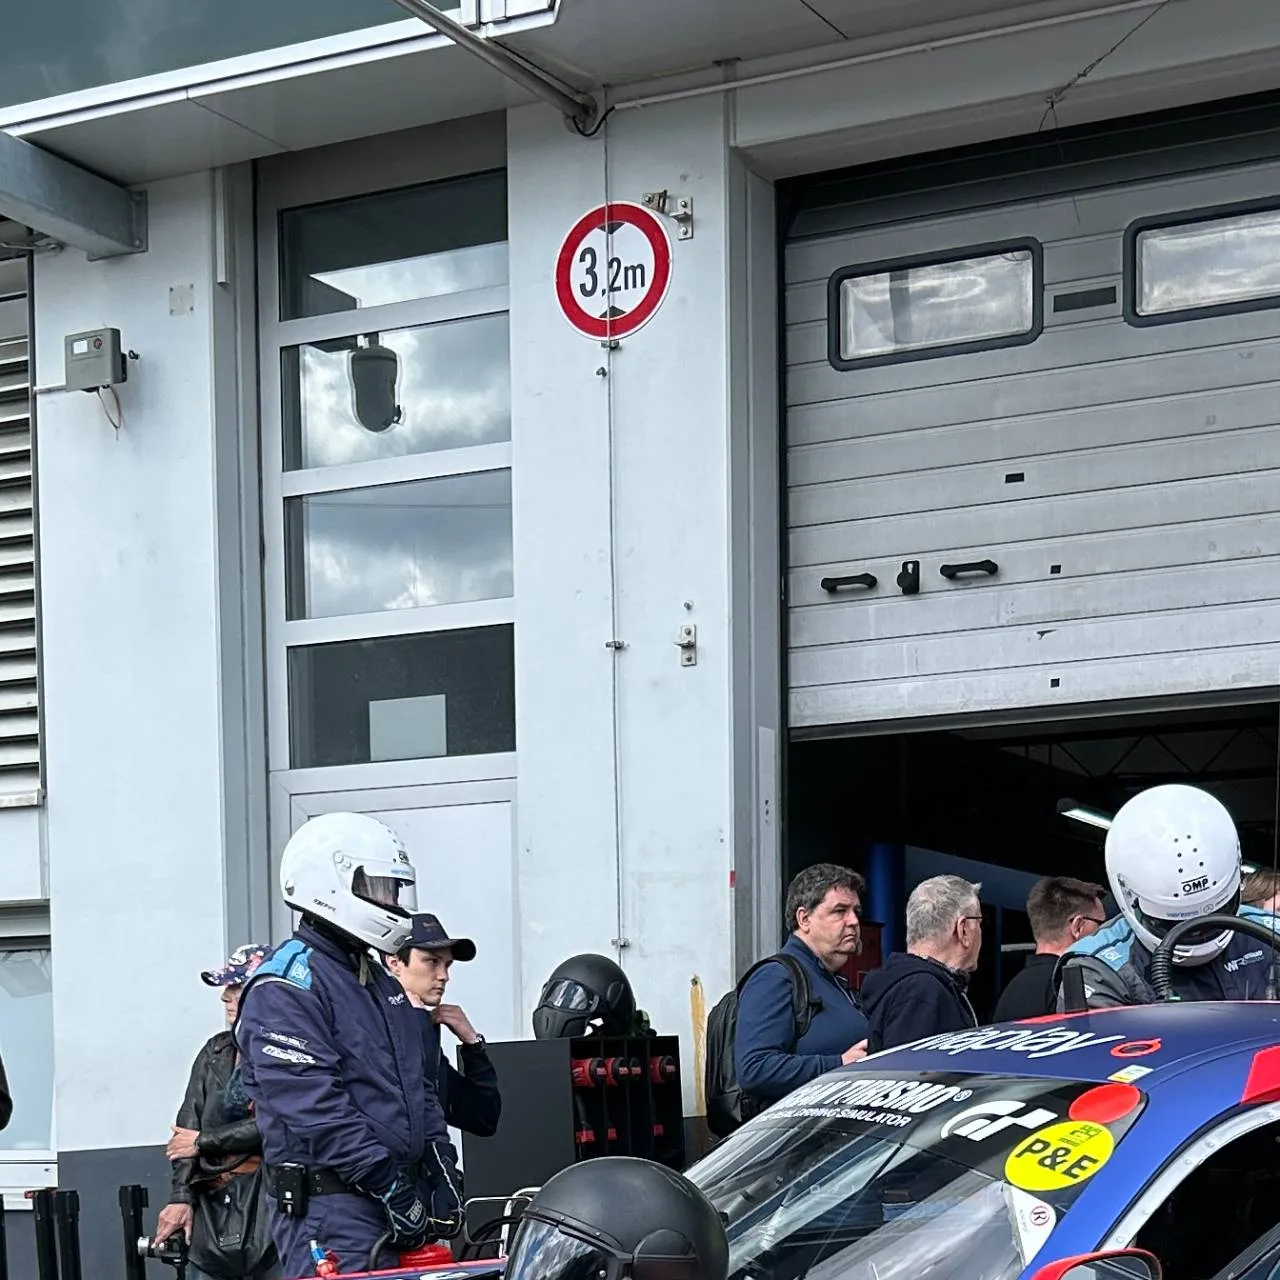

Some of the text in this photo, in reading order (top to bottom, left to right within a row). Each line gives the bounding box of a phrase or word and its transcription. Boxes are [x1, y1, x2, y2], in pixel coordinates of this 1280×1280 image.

[579, 247, 646, 298] 3,2m
[1183, 878, 1208, 893] OMP
[835, 1108, 913, 1127] SIMULATOR
[1015, 1138, 1100, 1180] P&E
